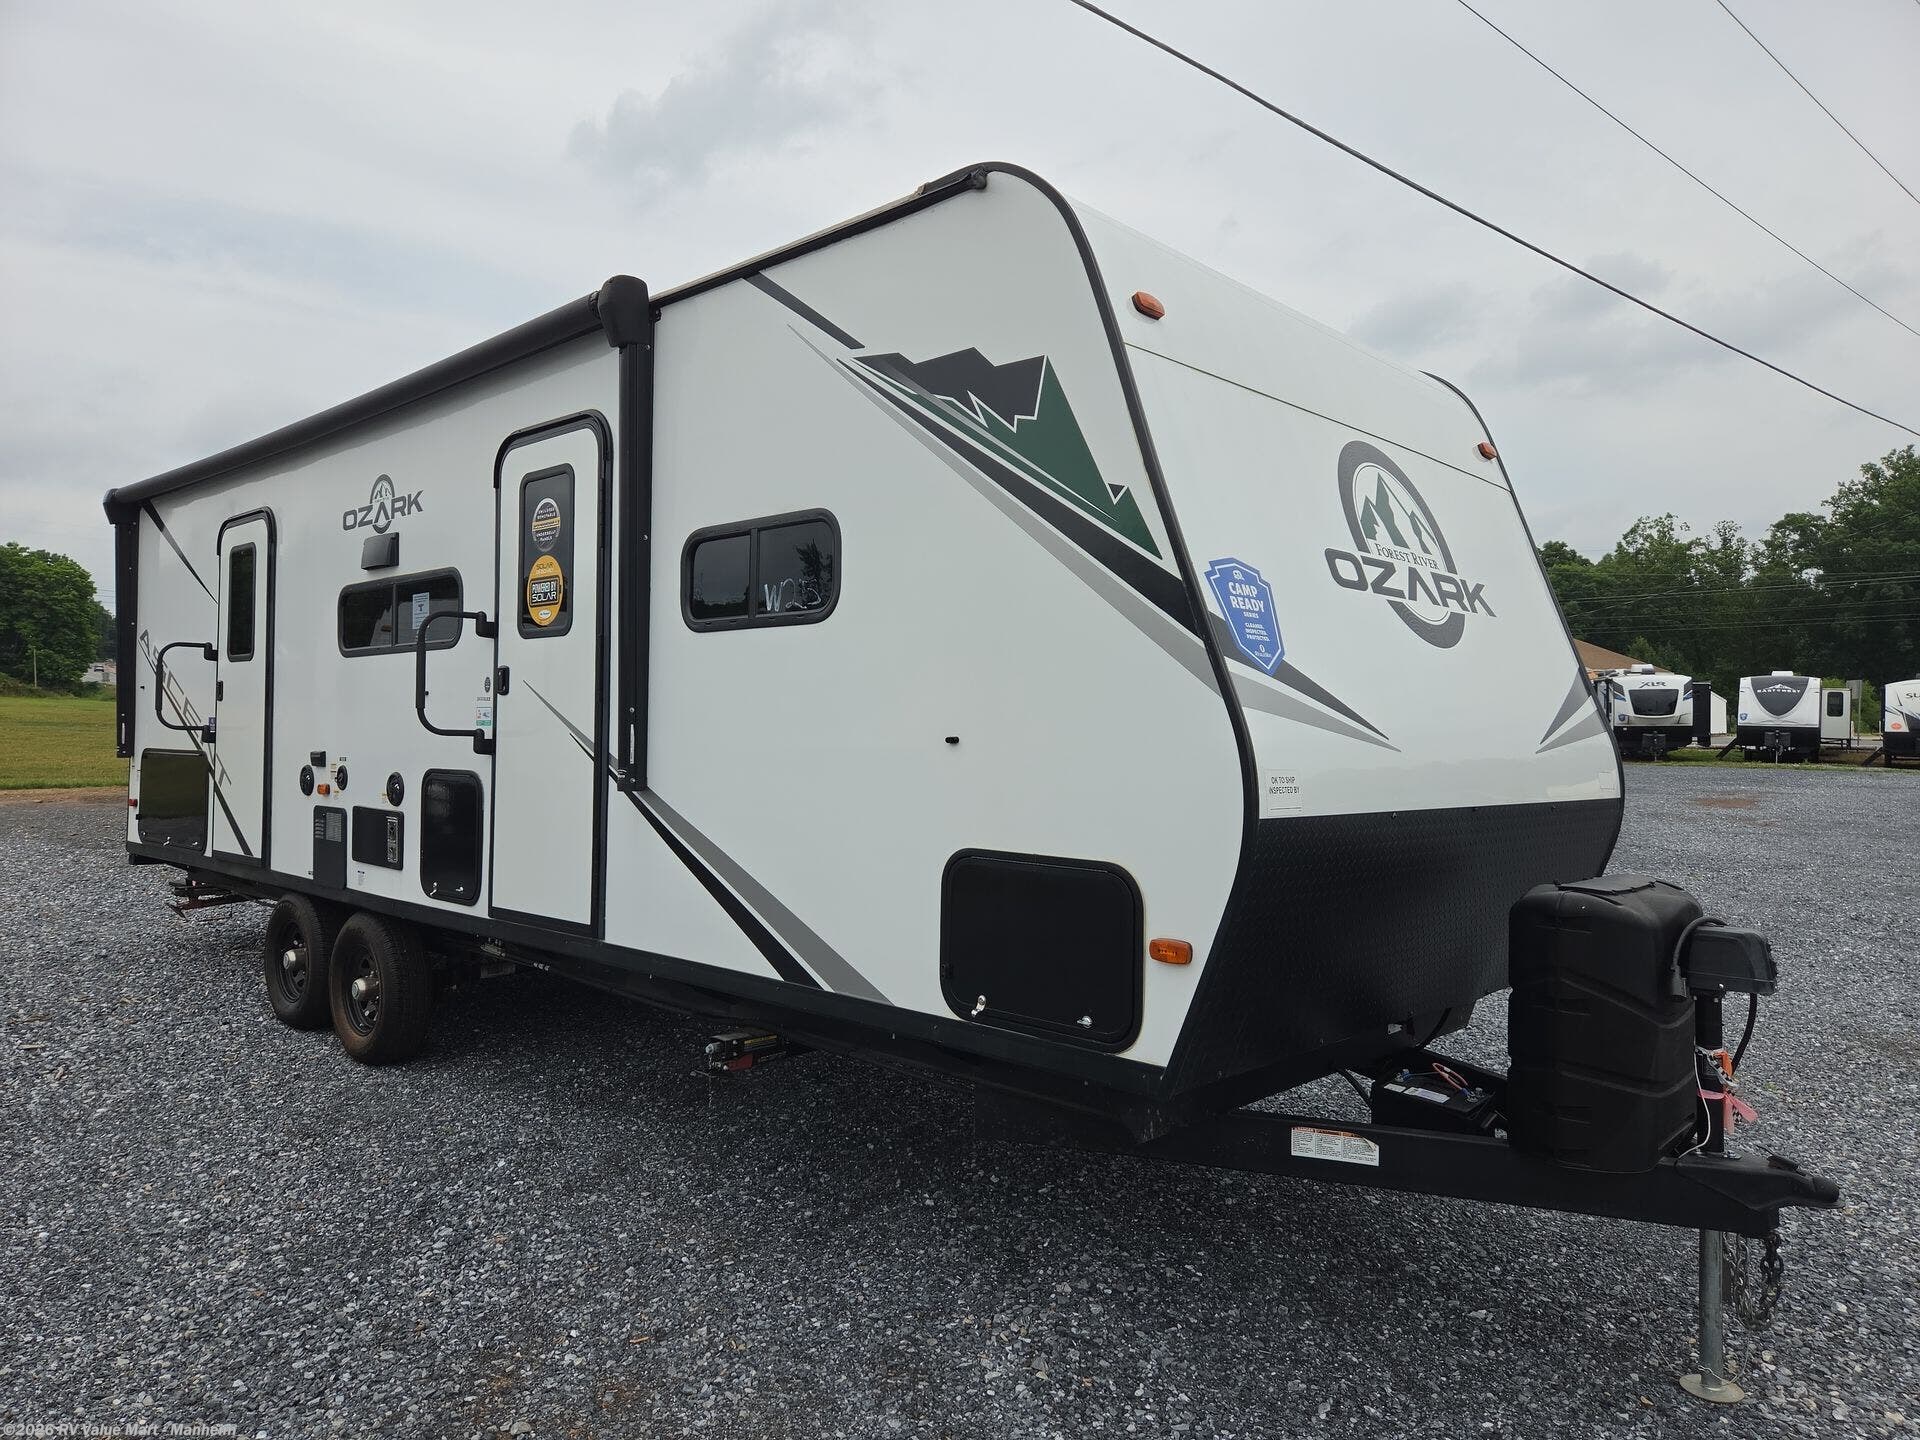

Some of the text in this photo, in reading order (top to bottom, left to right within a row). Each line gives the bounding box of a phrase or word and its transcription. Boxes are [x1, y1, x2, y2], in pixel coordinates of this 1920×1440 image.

[343, 489, 424, 531] OZARK
[1375, 543, 1440, 570] FOREST RIVER
[531, 582, 551, 594] POWERED
[1228, 581, 1258, 597] CAMP
[1324, 547, 1497, 617] OZARK
[531, 592, 557, 603] SOLAR
[1229, 595, 1265, 612] READY
[1271, 776, 1278, 784] OK
[1269, 786, 1293, 794] INSPECTED
